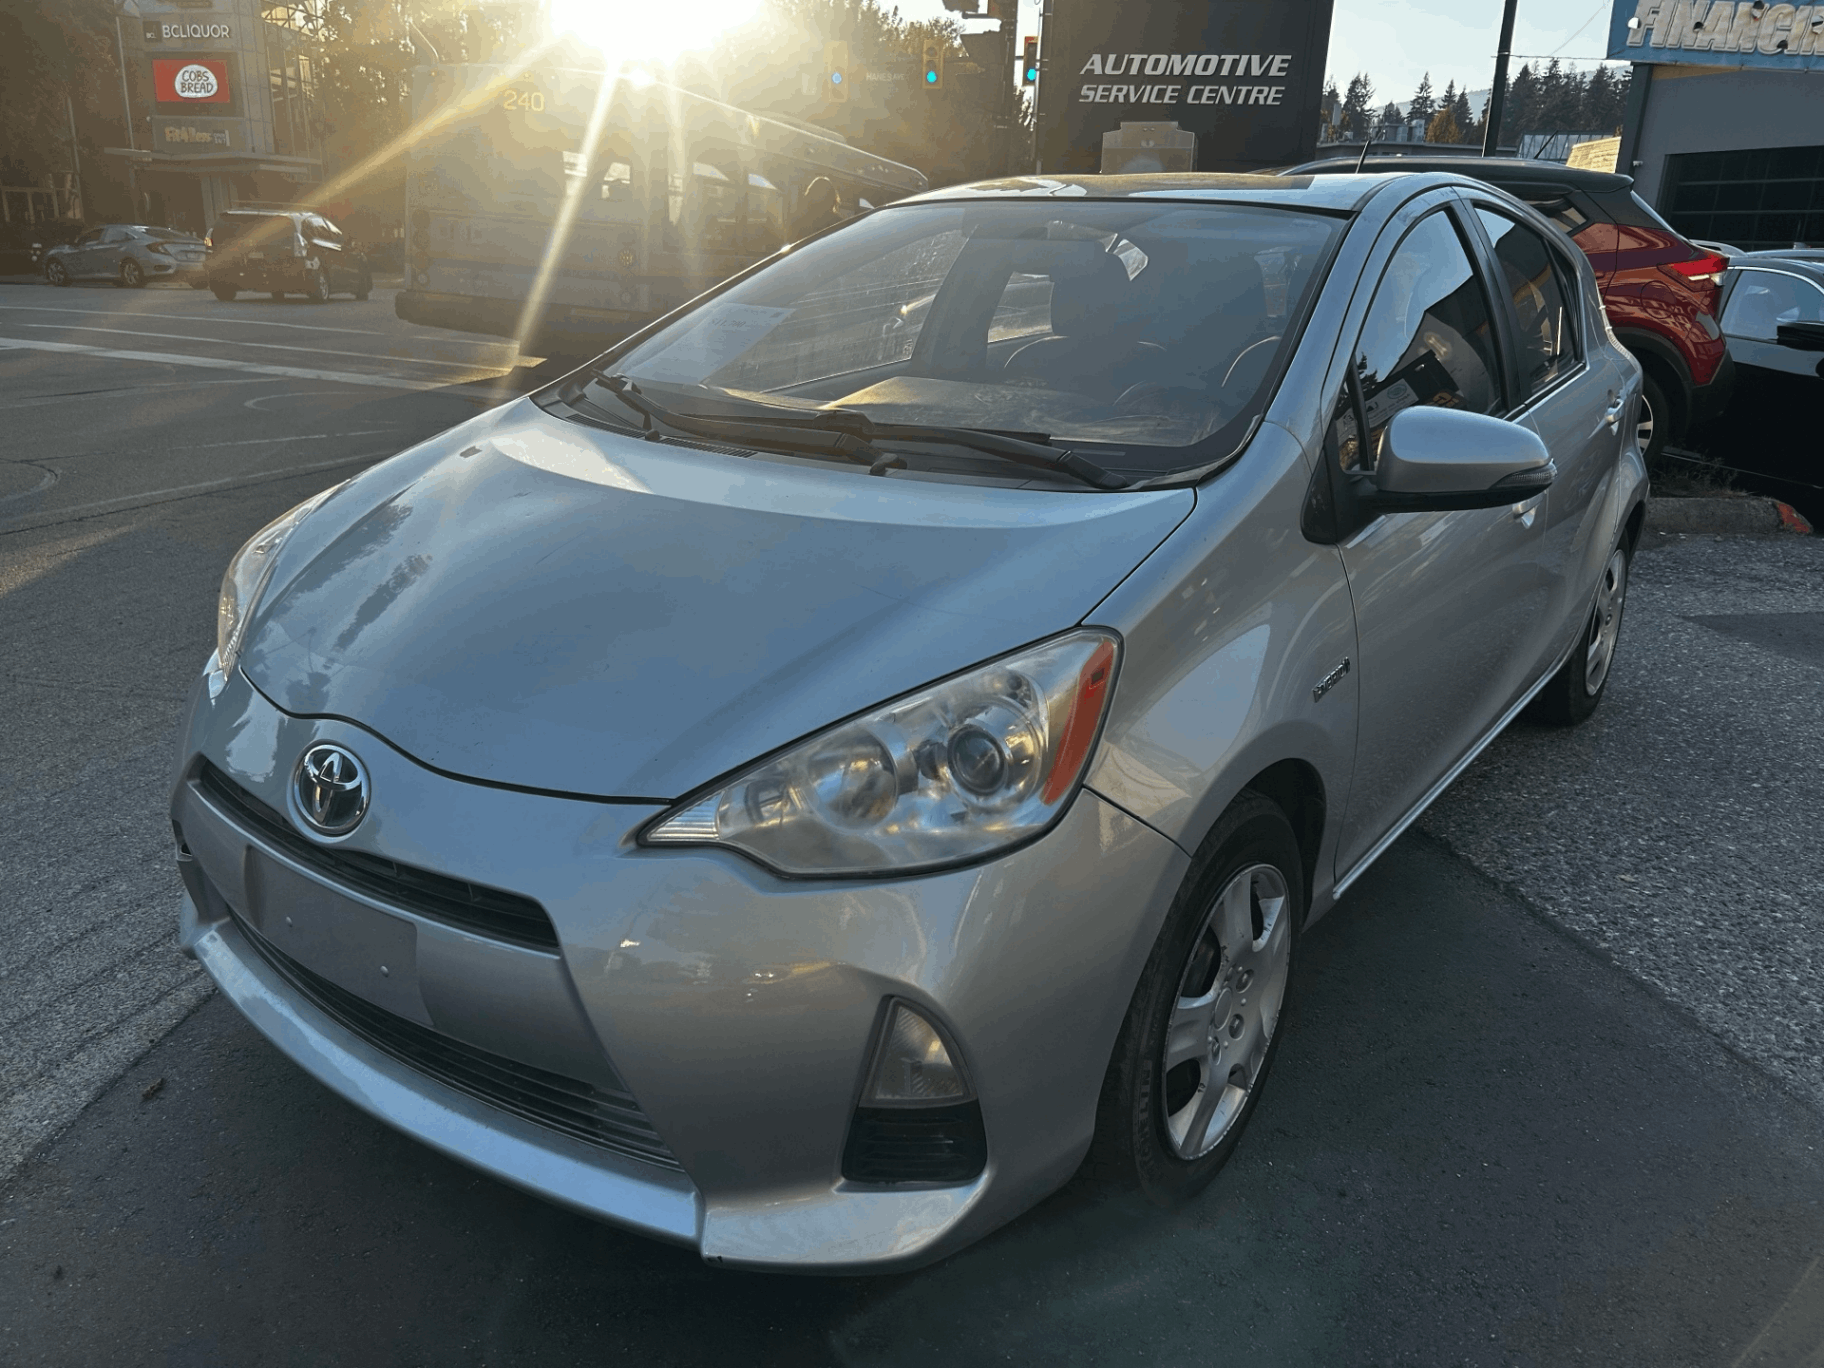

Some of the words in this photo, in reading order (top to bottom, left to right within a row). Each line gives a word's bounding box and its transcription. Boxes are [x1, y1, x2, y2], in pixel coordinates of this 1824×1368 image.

[1079, 53, 1292, 77] AUTOMOTIVE
[181, 70, 209, 82] COBS
[180, 82, 214, 93] BREAD
[1079, 84, 1180, 104] SERVICE
[1186, 85, 1286, 105] CENTRE
[503, 89, 545, 112] 240
